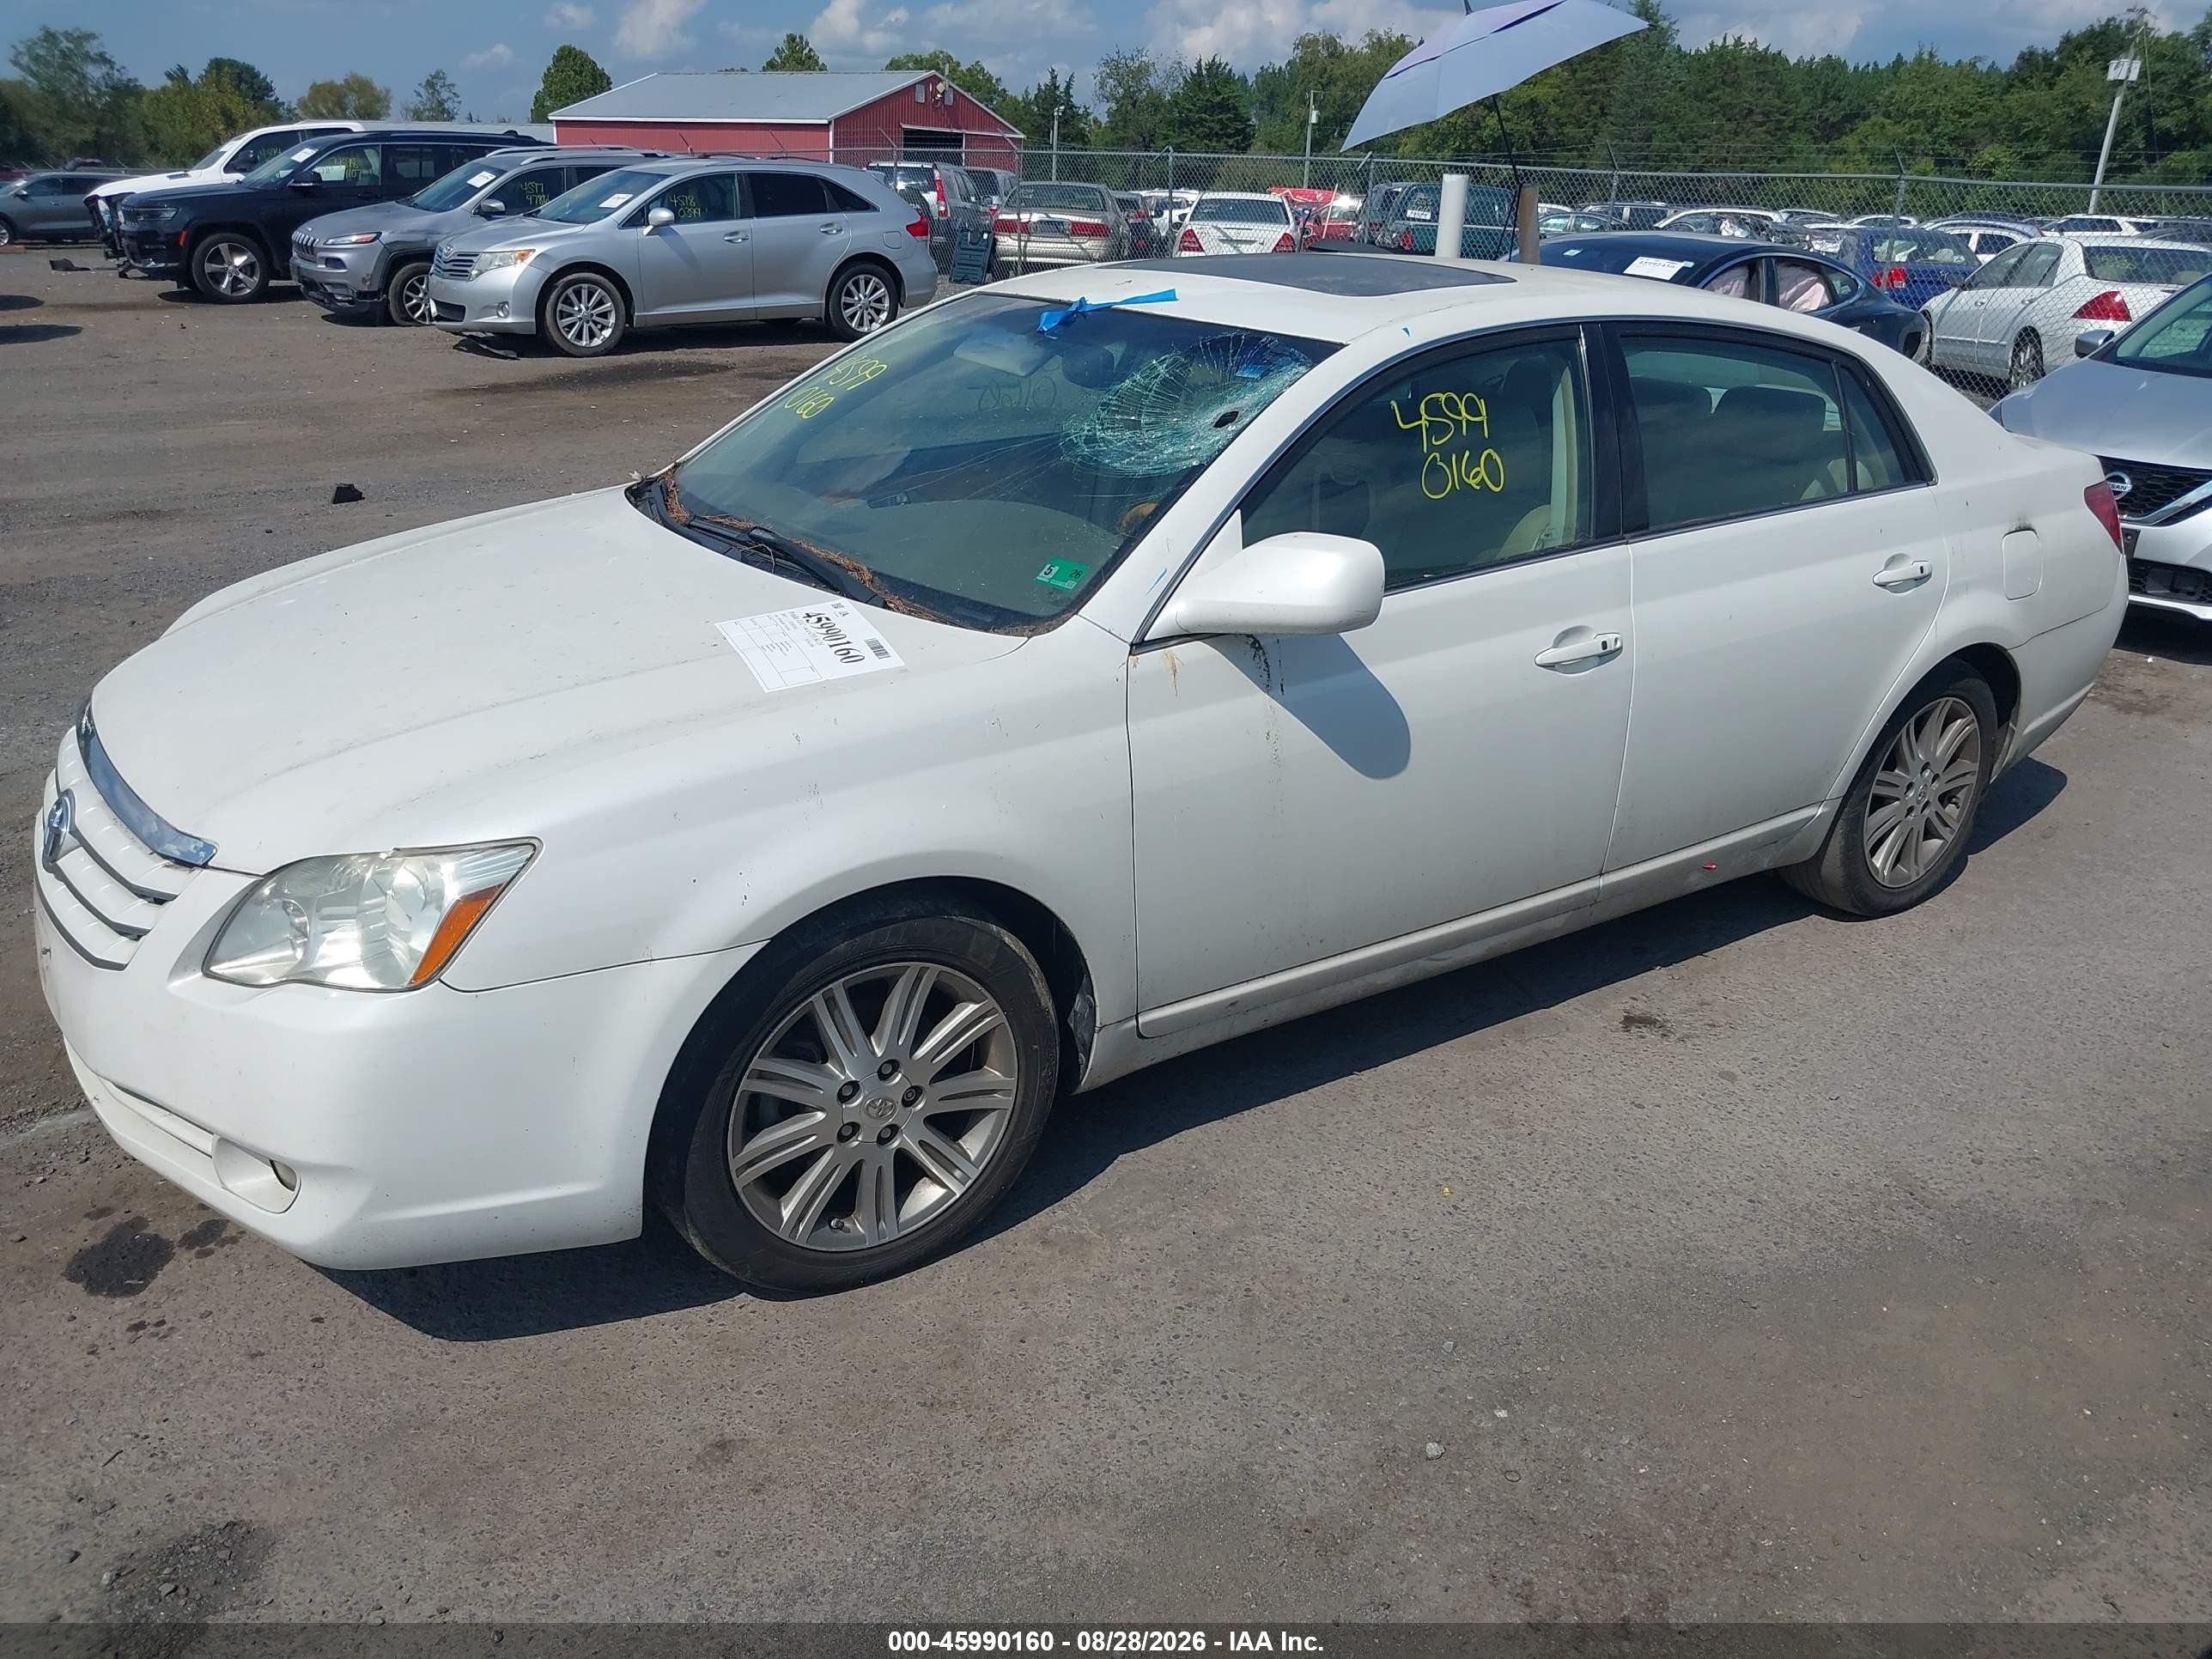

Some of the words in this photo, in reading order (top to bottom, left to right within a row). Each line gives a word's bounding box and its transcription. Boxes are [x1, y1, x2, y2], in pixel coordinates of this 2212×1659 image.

[823, 355, 888, 392] 4599
[783, 386, 836, 419] 0160
[1389, 392, 1490, 454] 4599
[1421, 447, 1505, 501] 0160
[1043, 564, 1055, 576] 5
[1068, 568, 1084, 580] 26
[802, 611, 866, 664] 45990160
